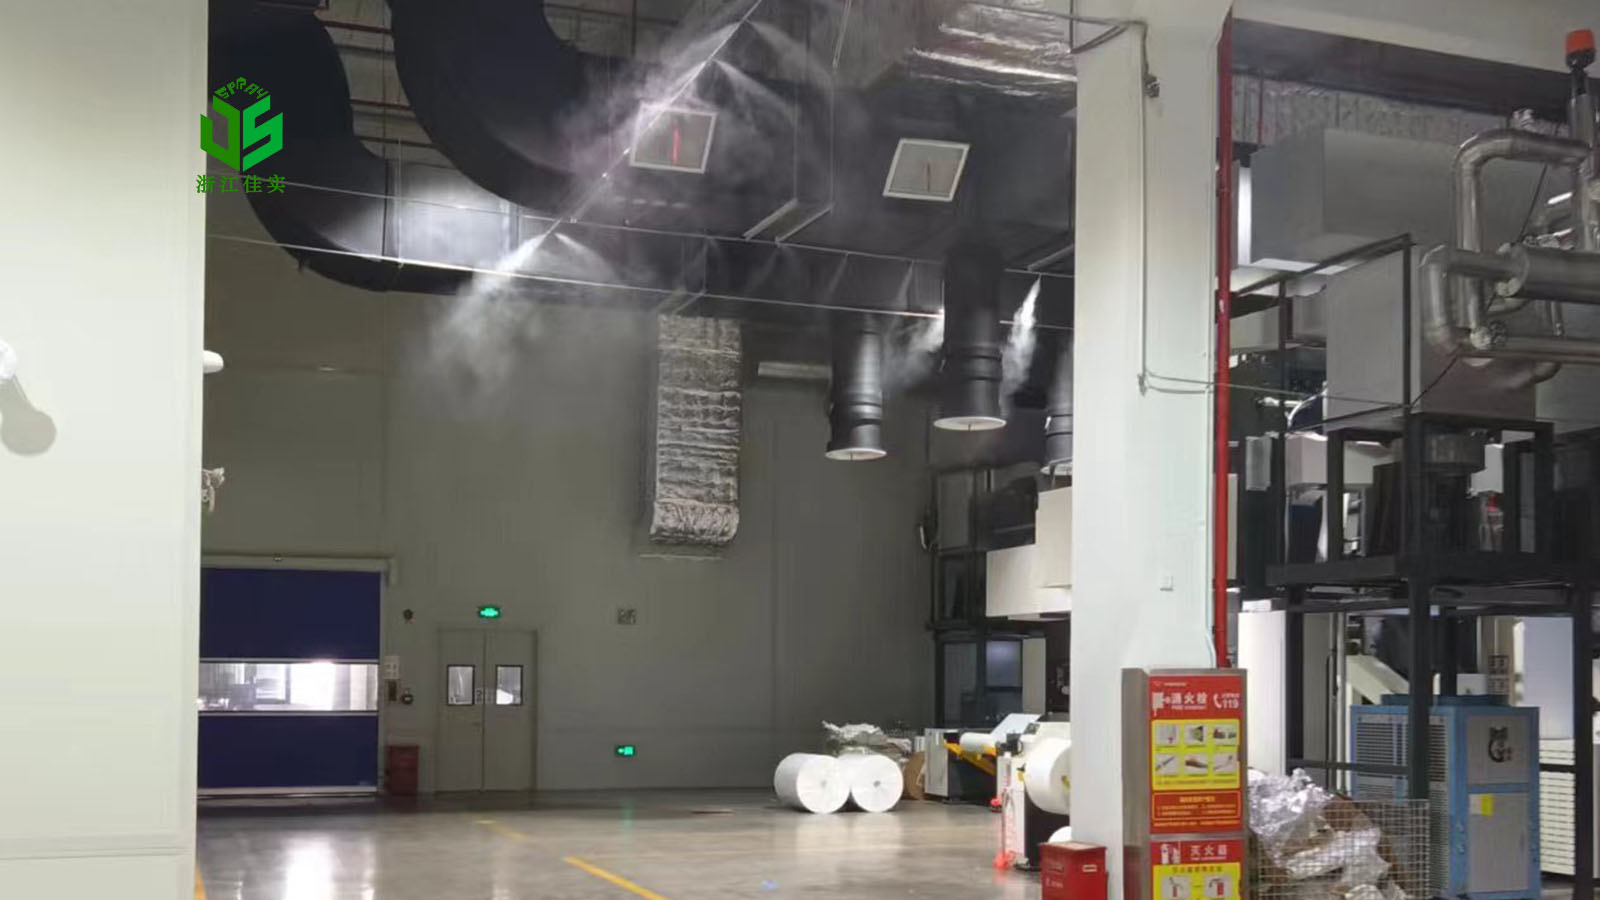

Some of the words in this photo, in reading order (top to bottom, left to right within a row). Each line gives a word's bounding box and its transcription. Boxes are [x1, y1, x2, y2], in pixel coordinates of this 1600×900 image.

[1171, 692, 1208, 705] 消火栓
[1222, 698, 1240, 709] 119
